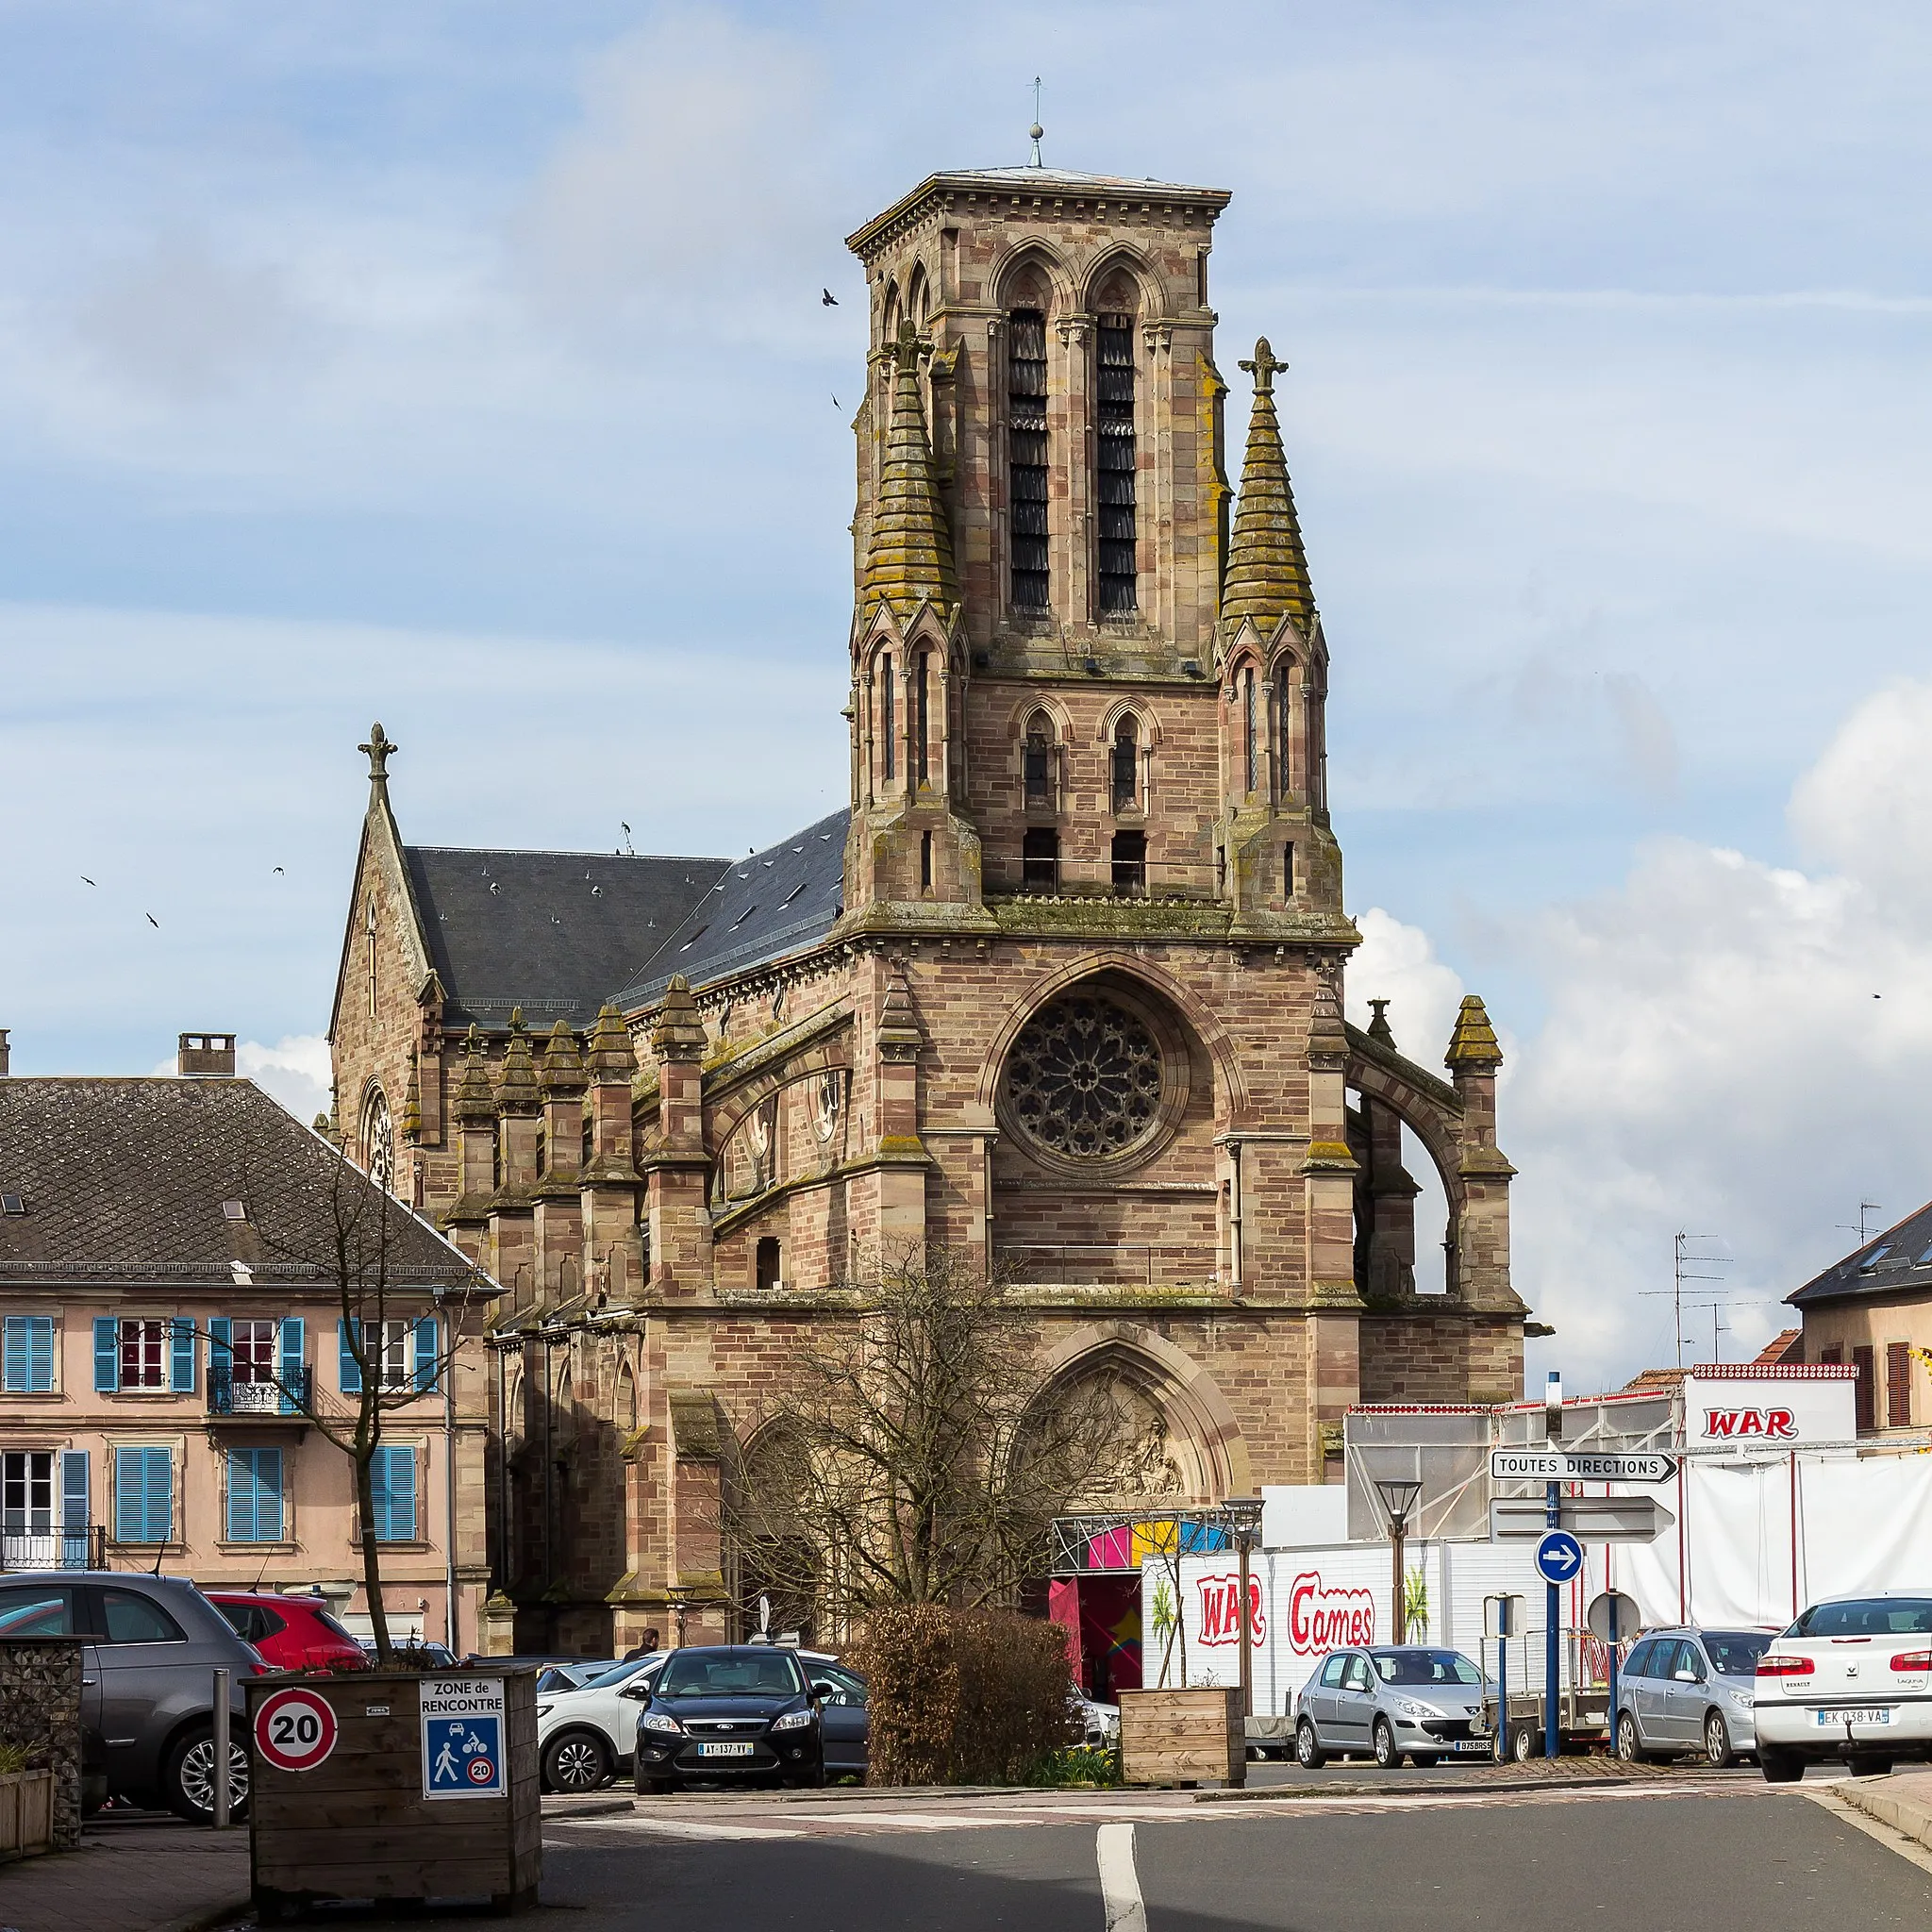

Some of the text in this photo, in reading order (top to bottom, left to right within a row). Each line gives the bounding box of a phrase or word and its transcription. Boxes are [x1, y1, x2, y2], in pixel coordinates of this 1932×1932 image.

[1707, 1410, 1795, 1437] WAR
[1500, 1458, 1658, 1474] TOUTES DIRECTIONS
[1203, 1583, 1374, 1646] WAR Games
[434, 1682, 490, 1695] ZONE de
[422, 1698, 503, 1712] RENCONTRE
[273, 1714, 319, 1744] 20
[473, 1765, 489, 1775] 20
